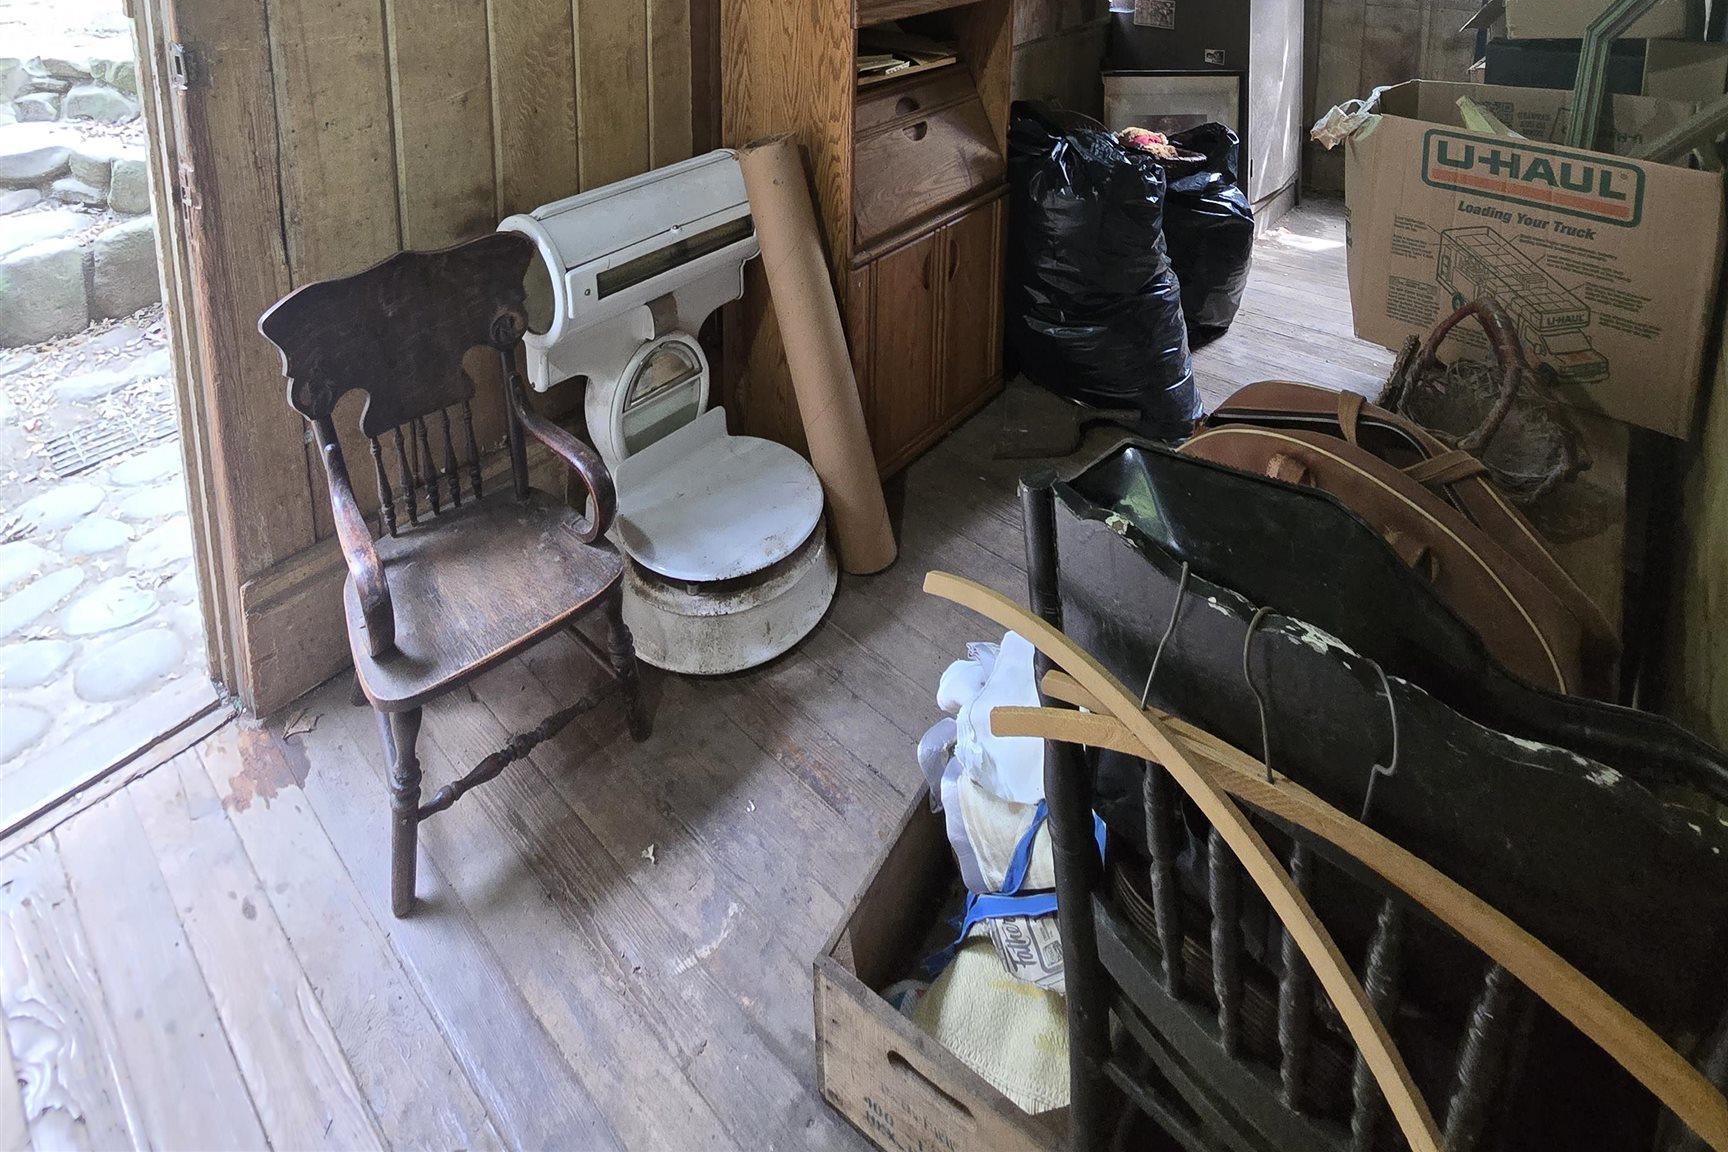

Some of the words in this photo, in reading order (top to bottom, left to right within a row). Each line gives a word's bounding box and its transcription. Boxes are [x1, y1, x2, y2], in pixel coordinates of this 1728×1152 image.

[1457, 200, 1513, 224] Loading
[1516, 212, 1550, 230] Your
[1553, 220, 1596, 240] Truck
